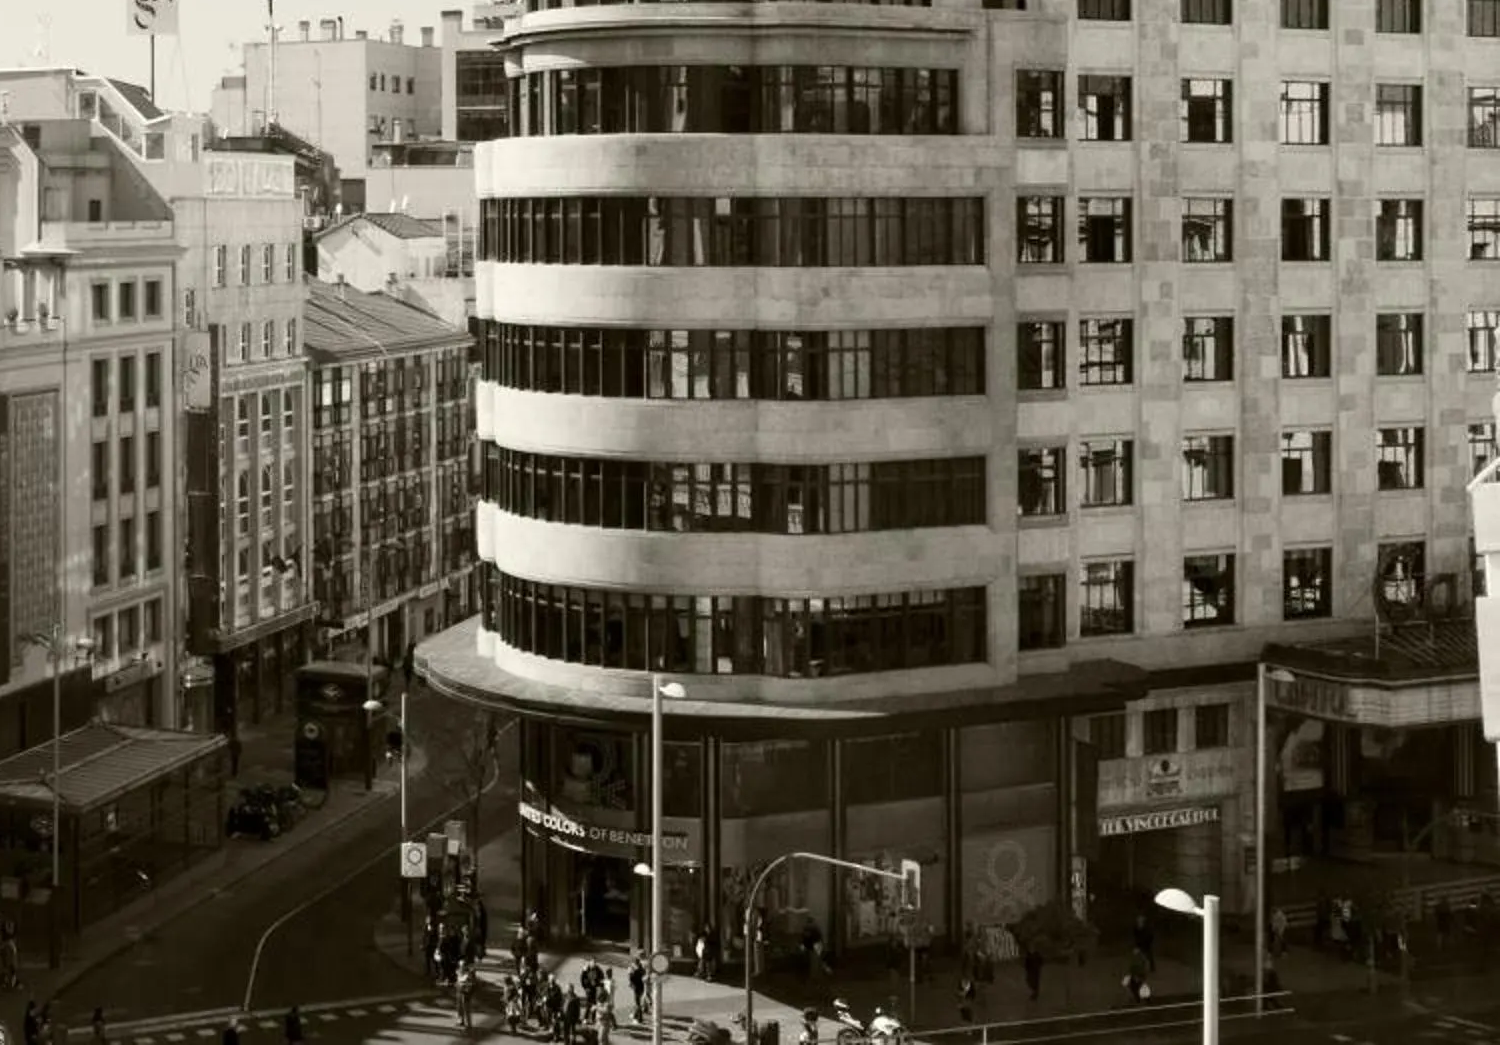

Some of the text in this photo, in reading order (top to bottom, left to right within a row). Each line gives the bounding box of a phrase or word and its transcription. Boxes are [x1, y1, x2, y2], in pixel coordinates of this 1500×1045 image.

[519, 801, 689, 850] ITED COLORS OF BENETON
